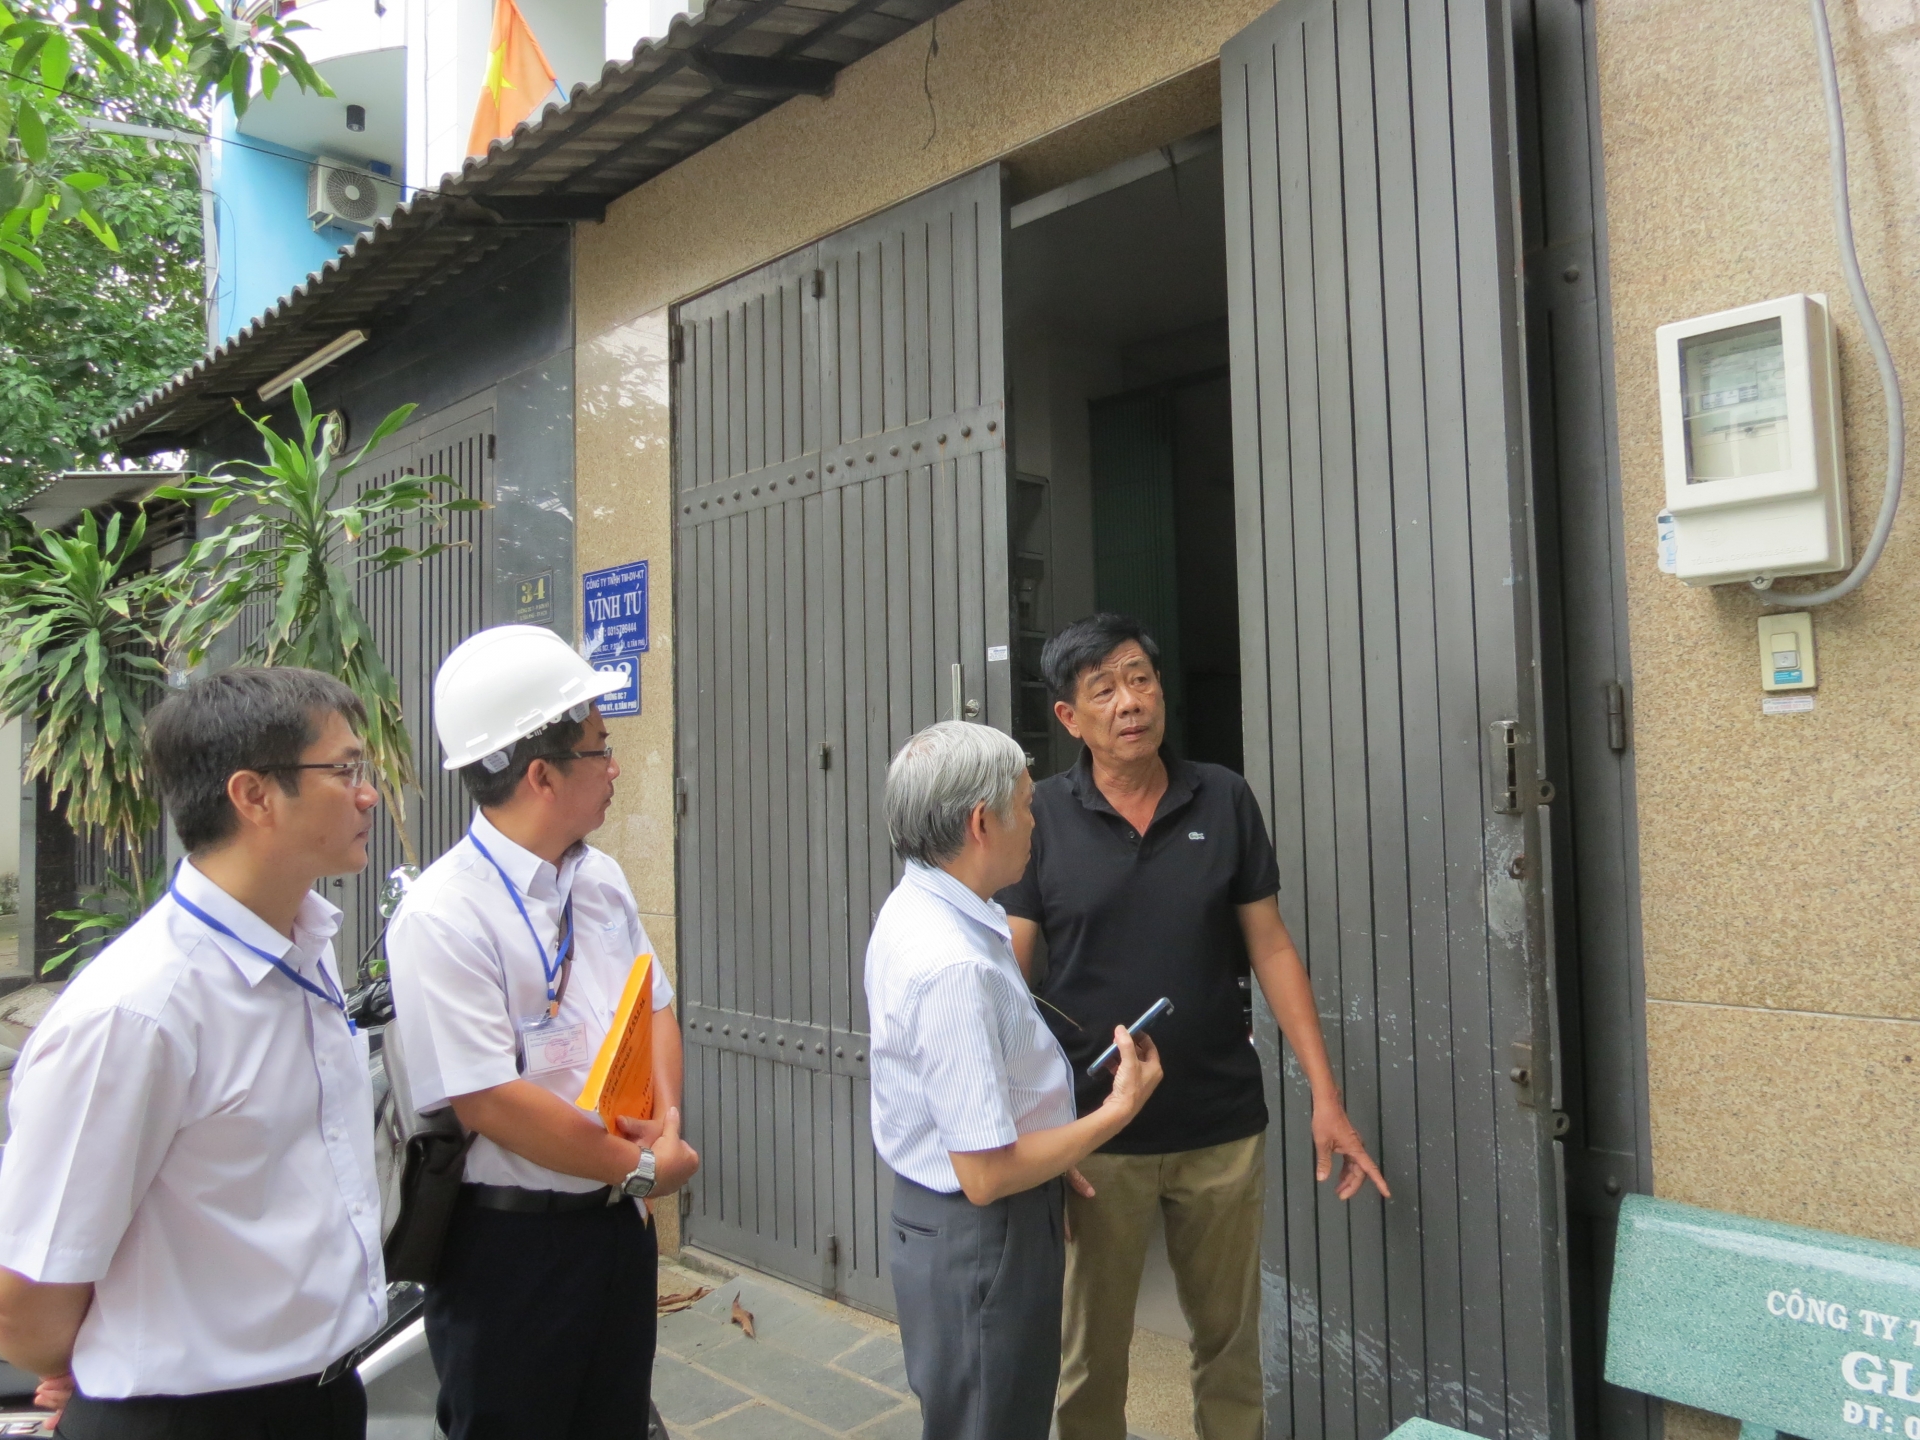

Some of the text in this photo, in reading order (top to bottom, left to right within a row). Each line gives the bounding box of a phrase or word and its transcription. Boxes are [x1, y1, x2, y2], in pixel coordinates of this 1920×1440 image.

[521, 578, 545, 604] 34
[600, 577, 607, 587] TY
[588, 591, 621, 622] VĨNH
[623, 583, 643, 616] TÚ
[1766, 1287, 1849, 1331] CÔNG
[1858, 1309, 1901, 1342] TY
[1842, 1399, 1894, 1434] ĐT:
